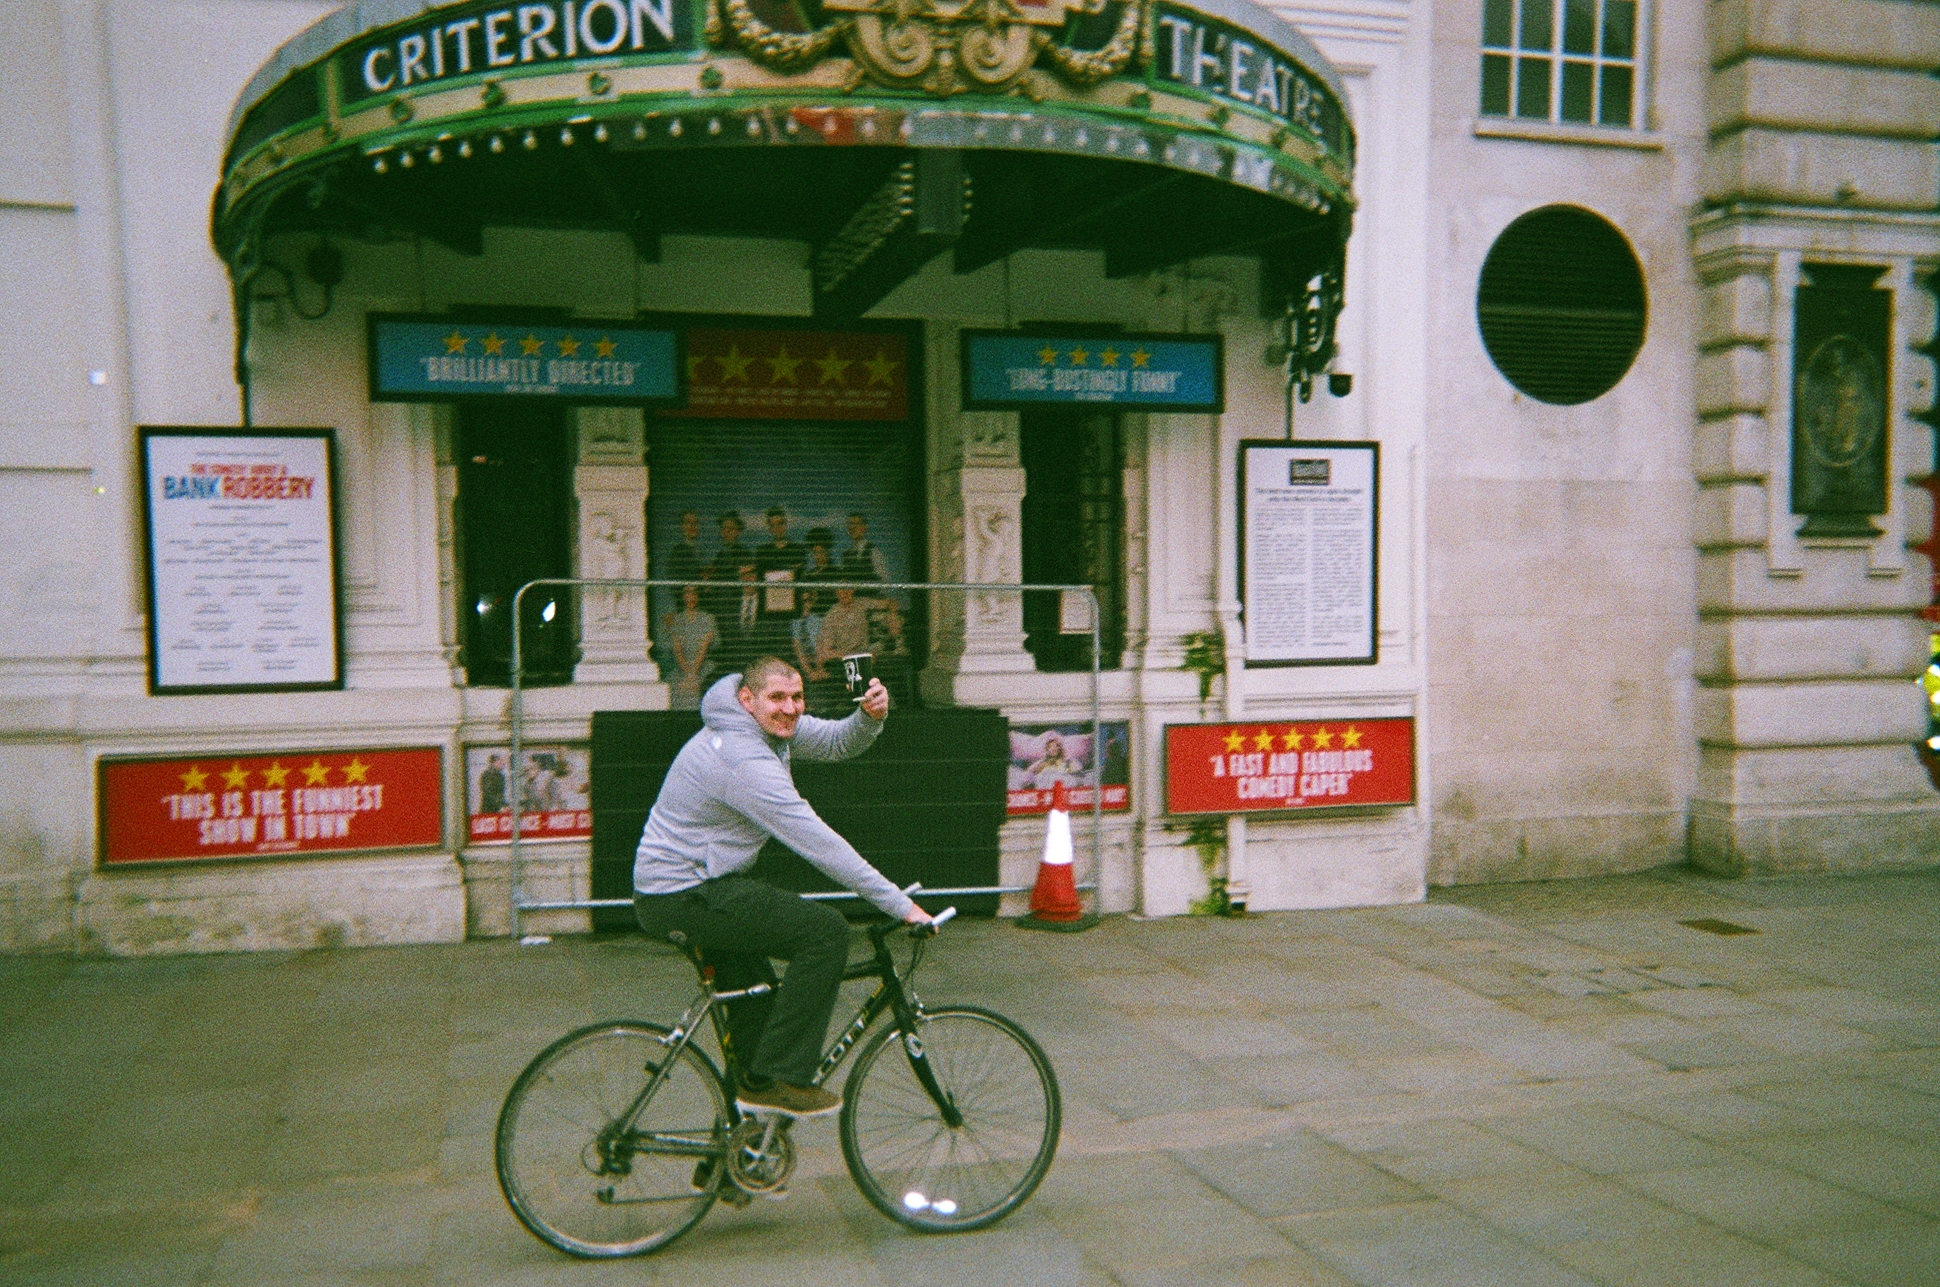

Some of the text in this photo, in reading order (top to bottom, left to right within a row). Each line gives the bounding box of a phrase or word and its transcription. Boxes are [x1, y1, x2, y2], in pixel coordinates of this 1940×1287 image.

[363, 0, 675, 92] CRITERION
[163, 476, 315, 500] BANK ROBBERY
[1229, 752, 1265, 777] FAST
[1268, 751, 1299, 776] AND
[221, 791, 244, 817] IS
[251, 789, 286, 816] THE
[292, 784, 384, 814] FUNNIEST
[1237, 775, 1297, 799] COMEDY
[198, 818, 257, 846] SHOW
[264, 815, 287, 842] IN
